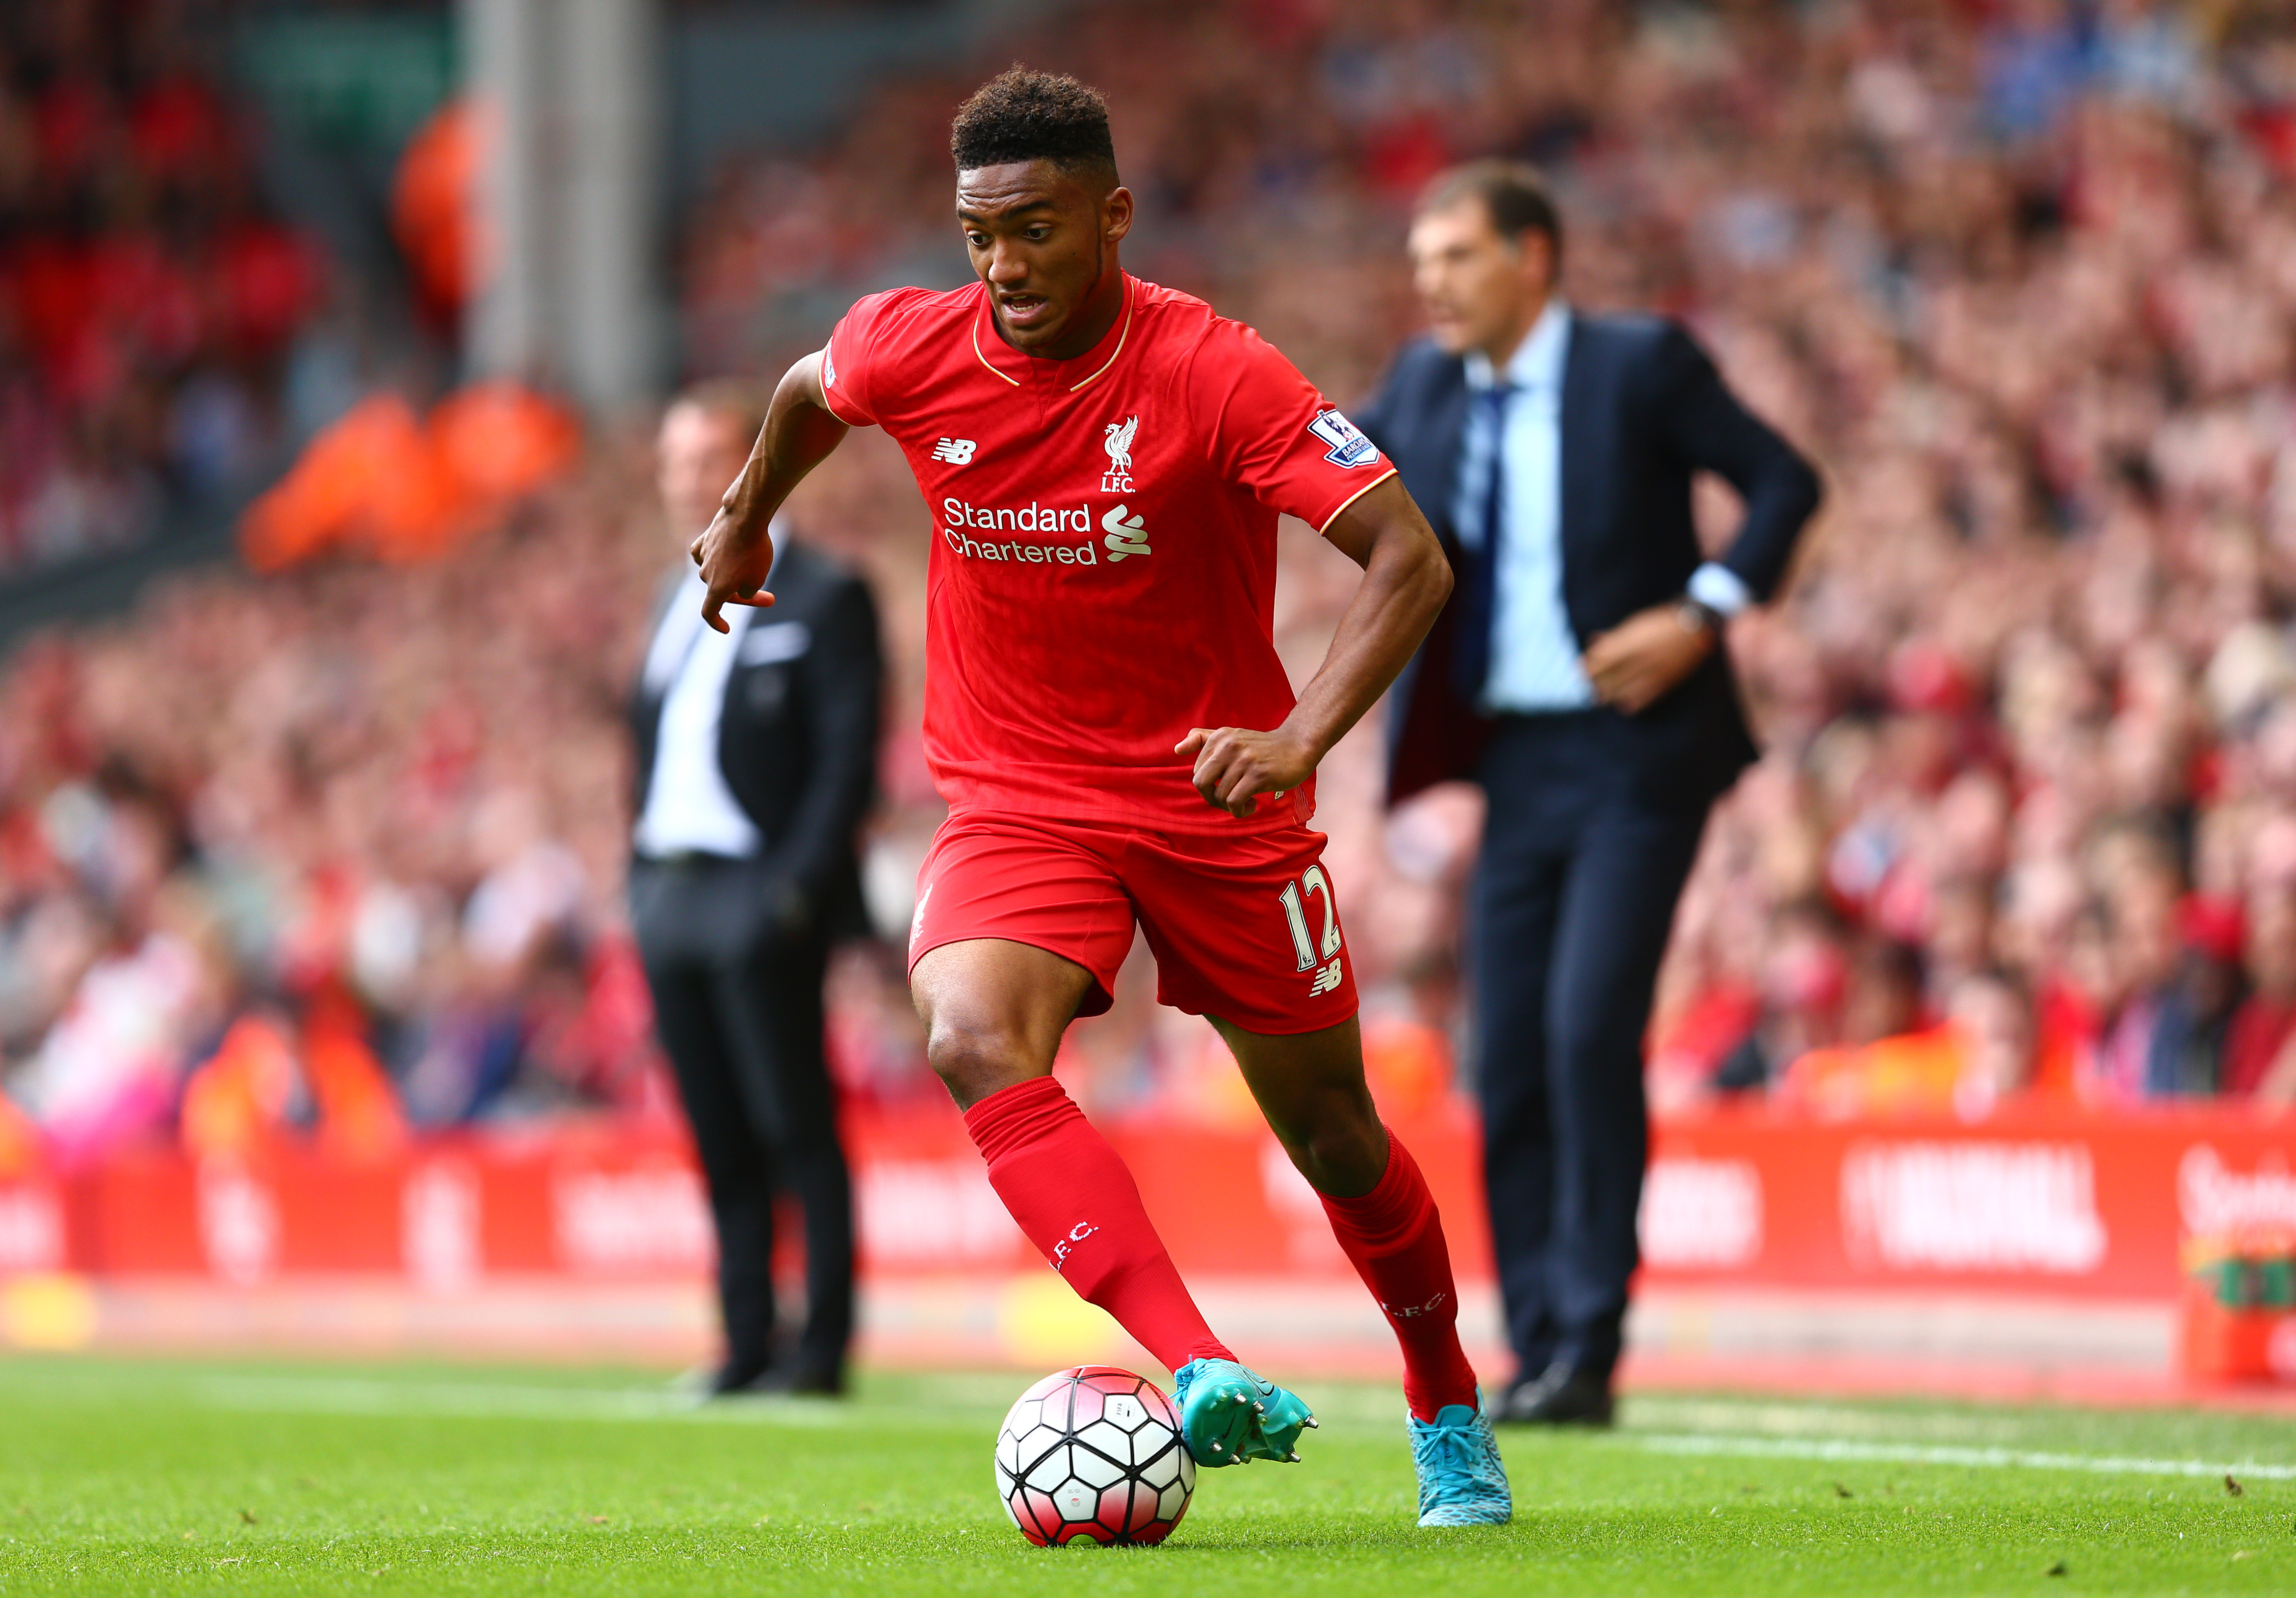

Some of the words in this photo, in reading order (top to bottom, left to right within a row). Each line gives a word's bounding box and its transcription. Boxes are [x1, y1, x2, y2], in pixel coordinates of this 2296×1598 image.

[931, 437, 977, 465] NB
[1100, 476, 1136, 493] L.F.C.
[943, 498, 1092, 532] Standard
[944, 528, 1097, 565] Chartered
[1279, 864, 1342, 972] 12
[1309, 958, 1342, 997] NB
